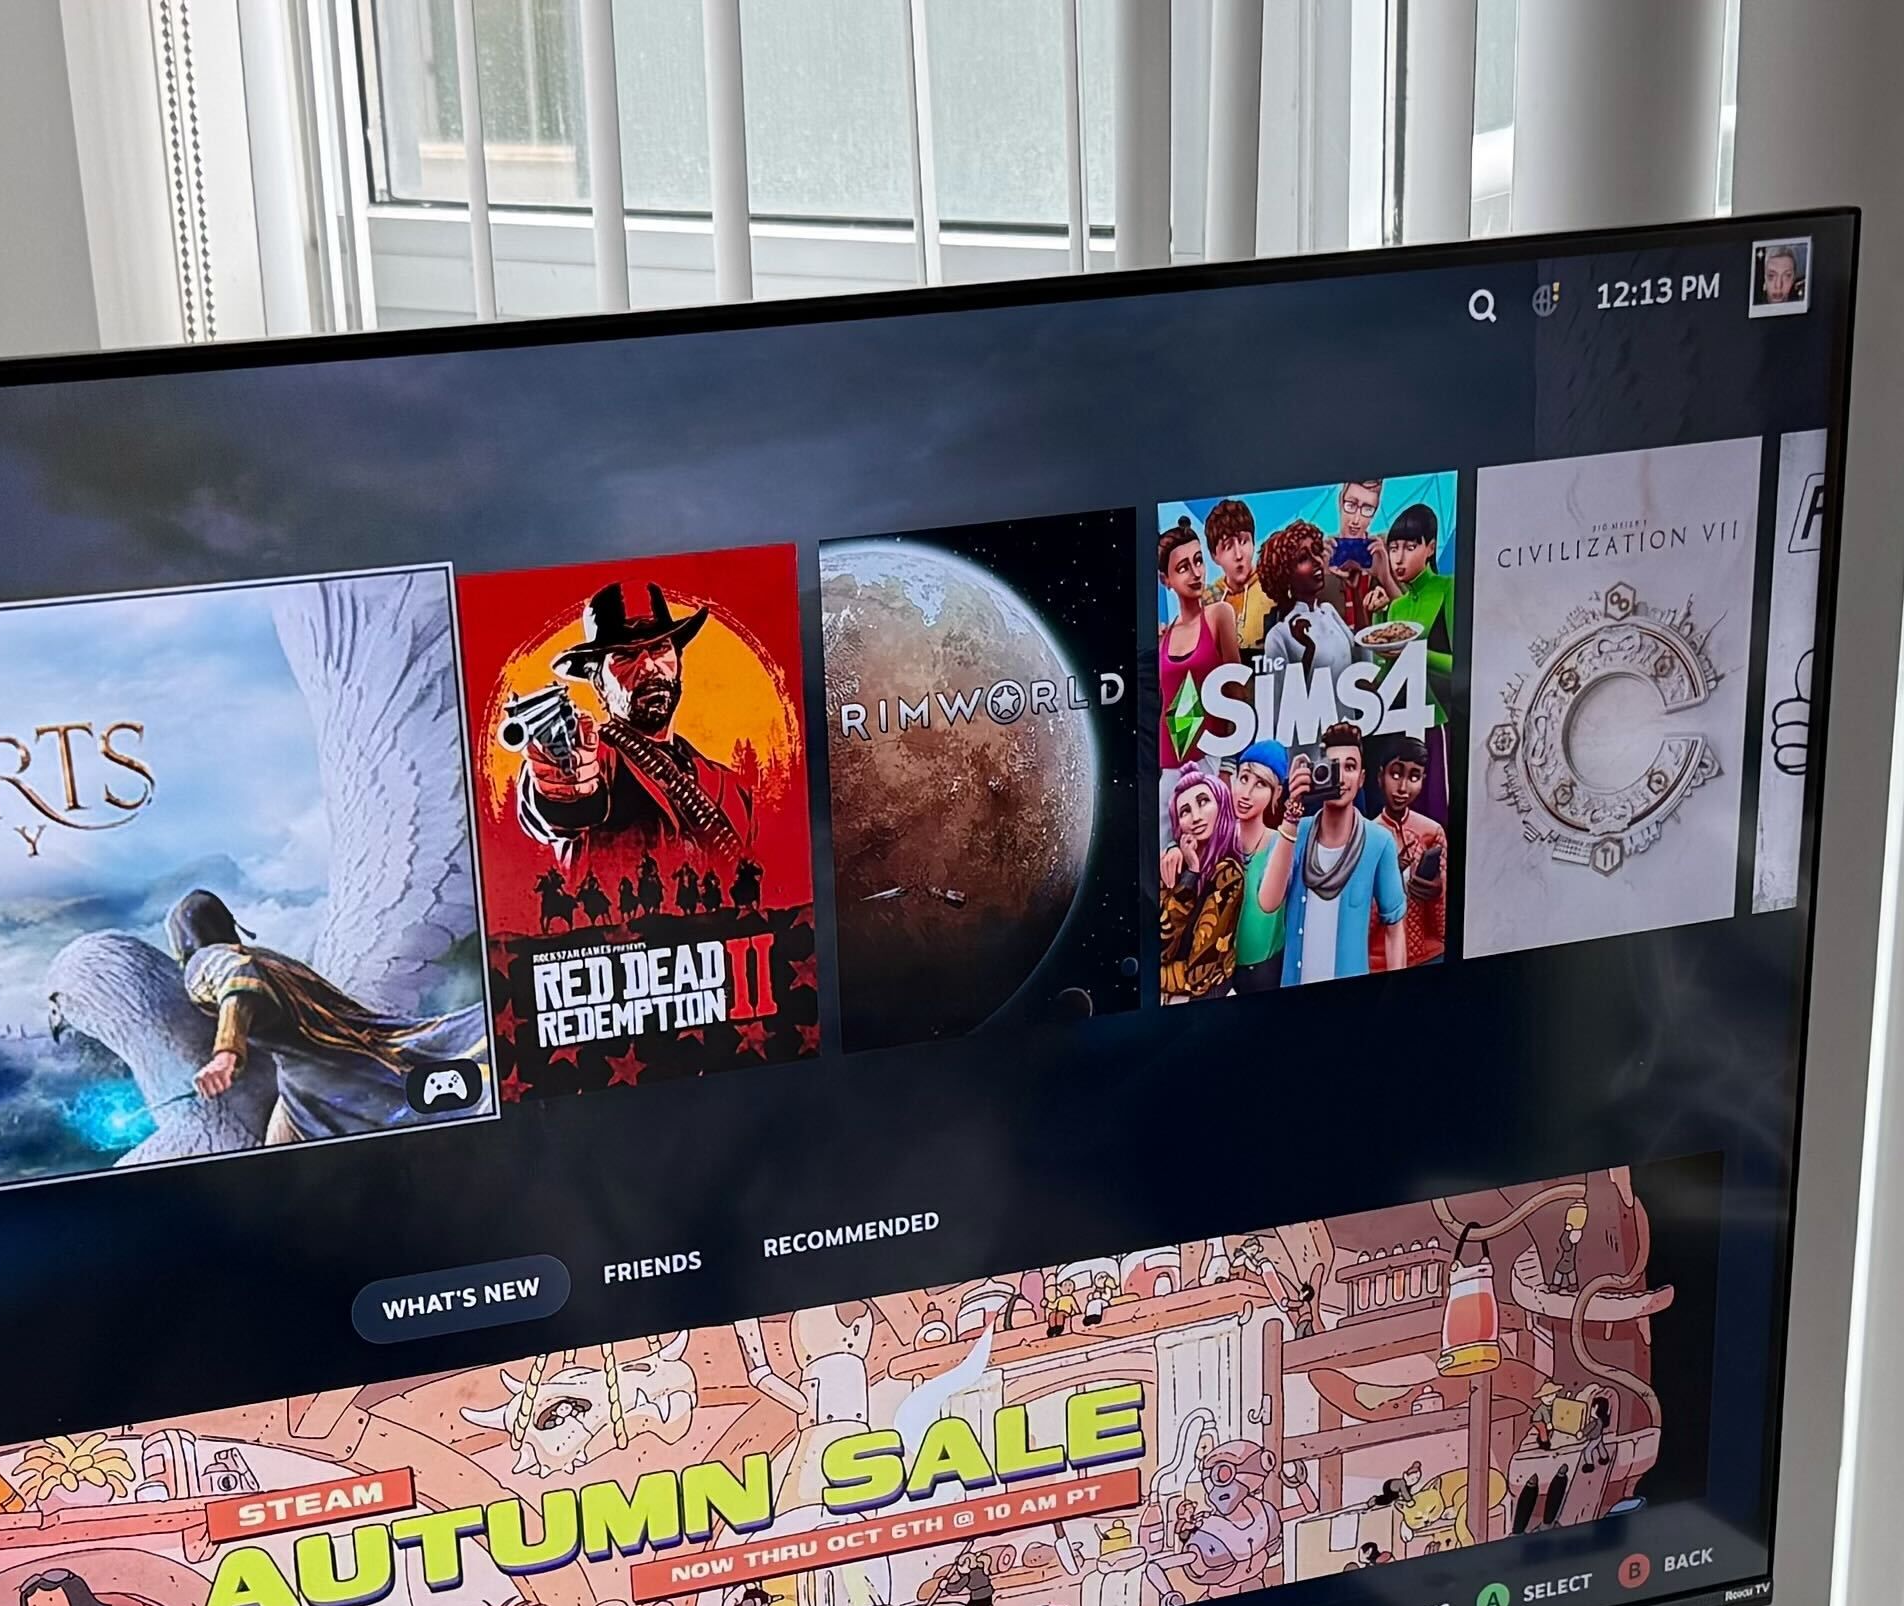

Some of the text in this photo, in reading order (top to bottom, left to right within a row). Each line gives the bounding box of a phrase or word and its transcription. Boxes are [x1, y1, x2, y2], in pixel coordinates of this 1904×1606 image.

[1597, 273, 1721, 309] 12:13 PM
[1496, 520, 1738, 569] CIVILIZATION VII
[1252, 652, 1285, 677] The
[840, 672, 1126, 742] RIMWORLD
[533, 949, 580, 963] ROCKSTAR
[581, 944, 611, 957] GAMES
[533, 941, 726, 1011] RED DEAD
[537, 933, 778, 1047] REDEMPTION II
[763, 1212, 940, 1258] RECOMMENDED
[603, 1251, 702, 1284] FRIENDS
[382, 1277, 541, 1320] WHAT'S NEW
[822, 1383, 1146, 1513] SALE
[238, 1482, 385, 1528] STEAM
[671, 1486, 1102, 1583] NOW THRU OCT 6TH @ 10 AM PT
[1664, 1547, 1714, 1573] BACK
[1523, 1573, 1593, 1602] SELECT
[1755, 1582, 1771, 1595] TV
